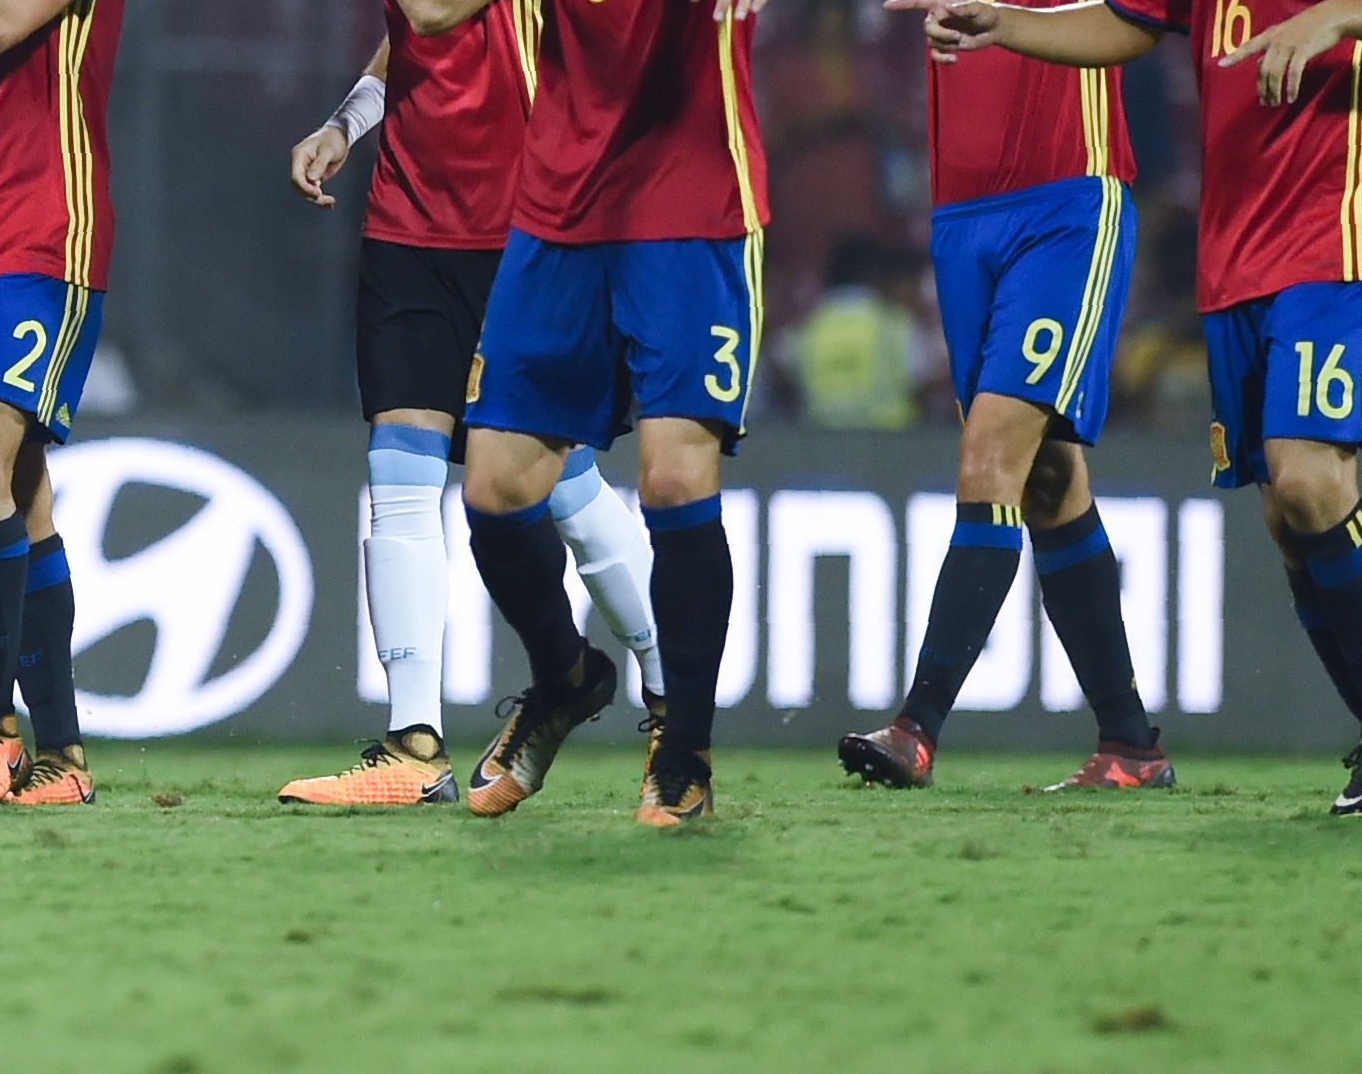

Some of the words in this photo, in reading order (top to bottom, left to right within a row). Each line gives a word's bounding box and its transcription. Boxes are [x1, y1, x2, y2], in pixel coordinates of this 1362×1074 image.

[3, 320, 46, 393] 2
[704, 325, 740, 403] 3
[1021, 318, 1063, 385] 9
[1295, 341, 1354, 419] 16
